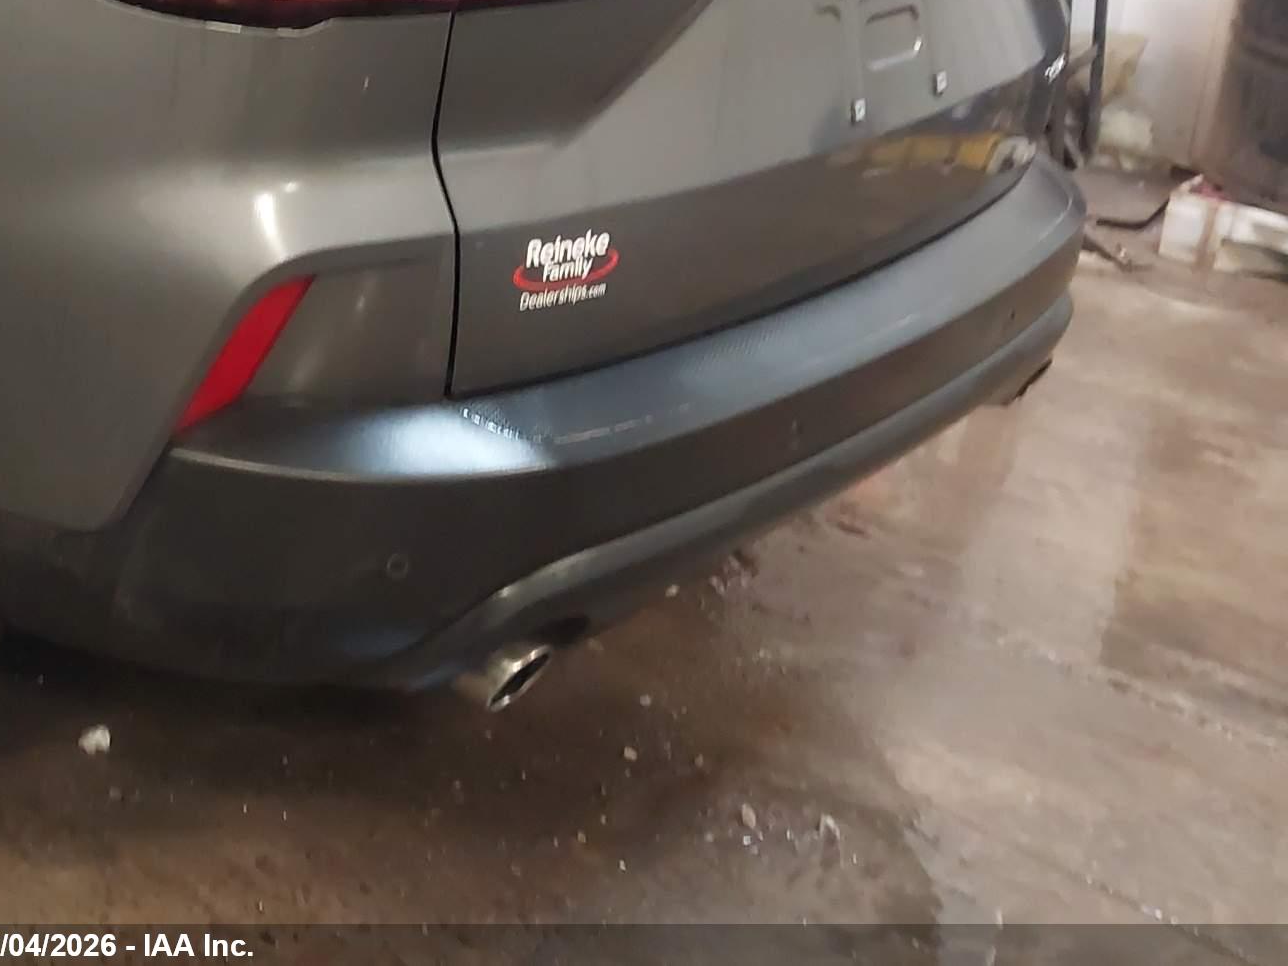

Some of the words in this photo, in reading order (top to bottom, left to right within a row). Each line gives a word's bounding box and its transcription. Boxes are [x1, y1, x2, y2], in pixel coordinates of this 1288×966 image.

[525, 229, 610, 269] Reineke
[542, 256, 594, 282] Family
[519, 283, 607, 312] Dealerships.com
